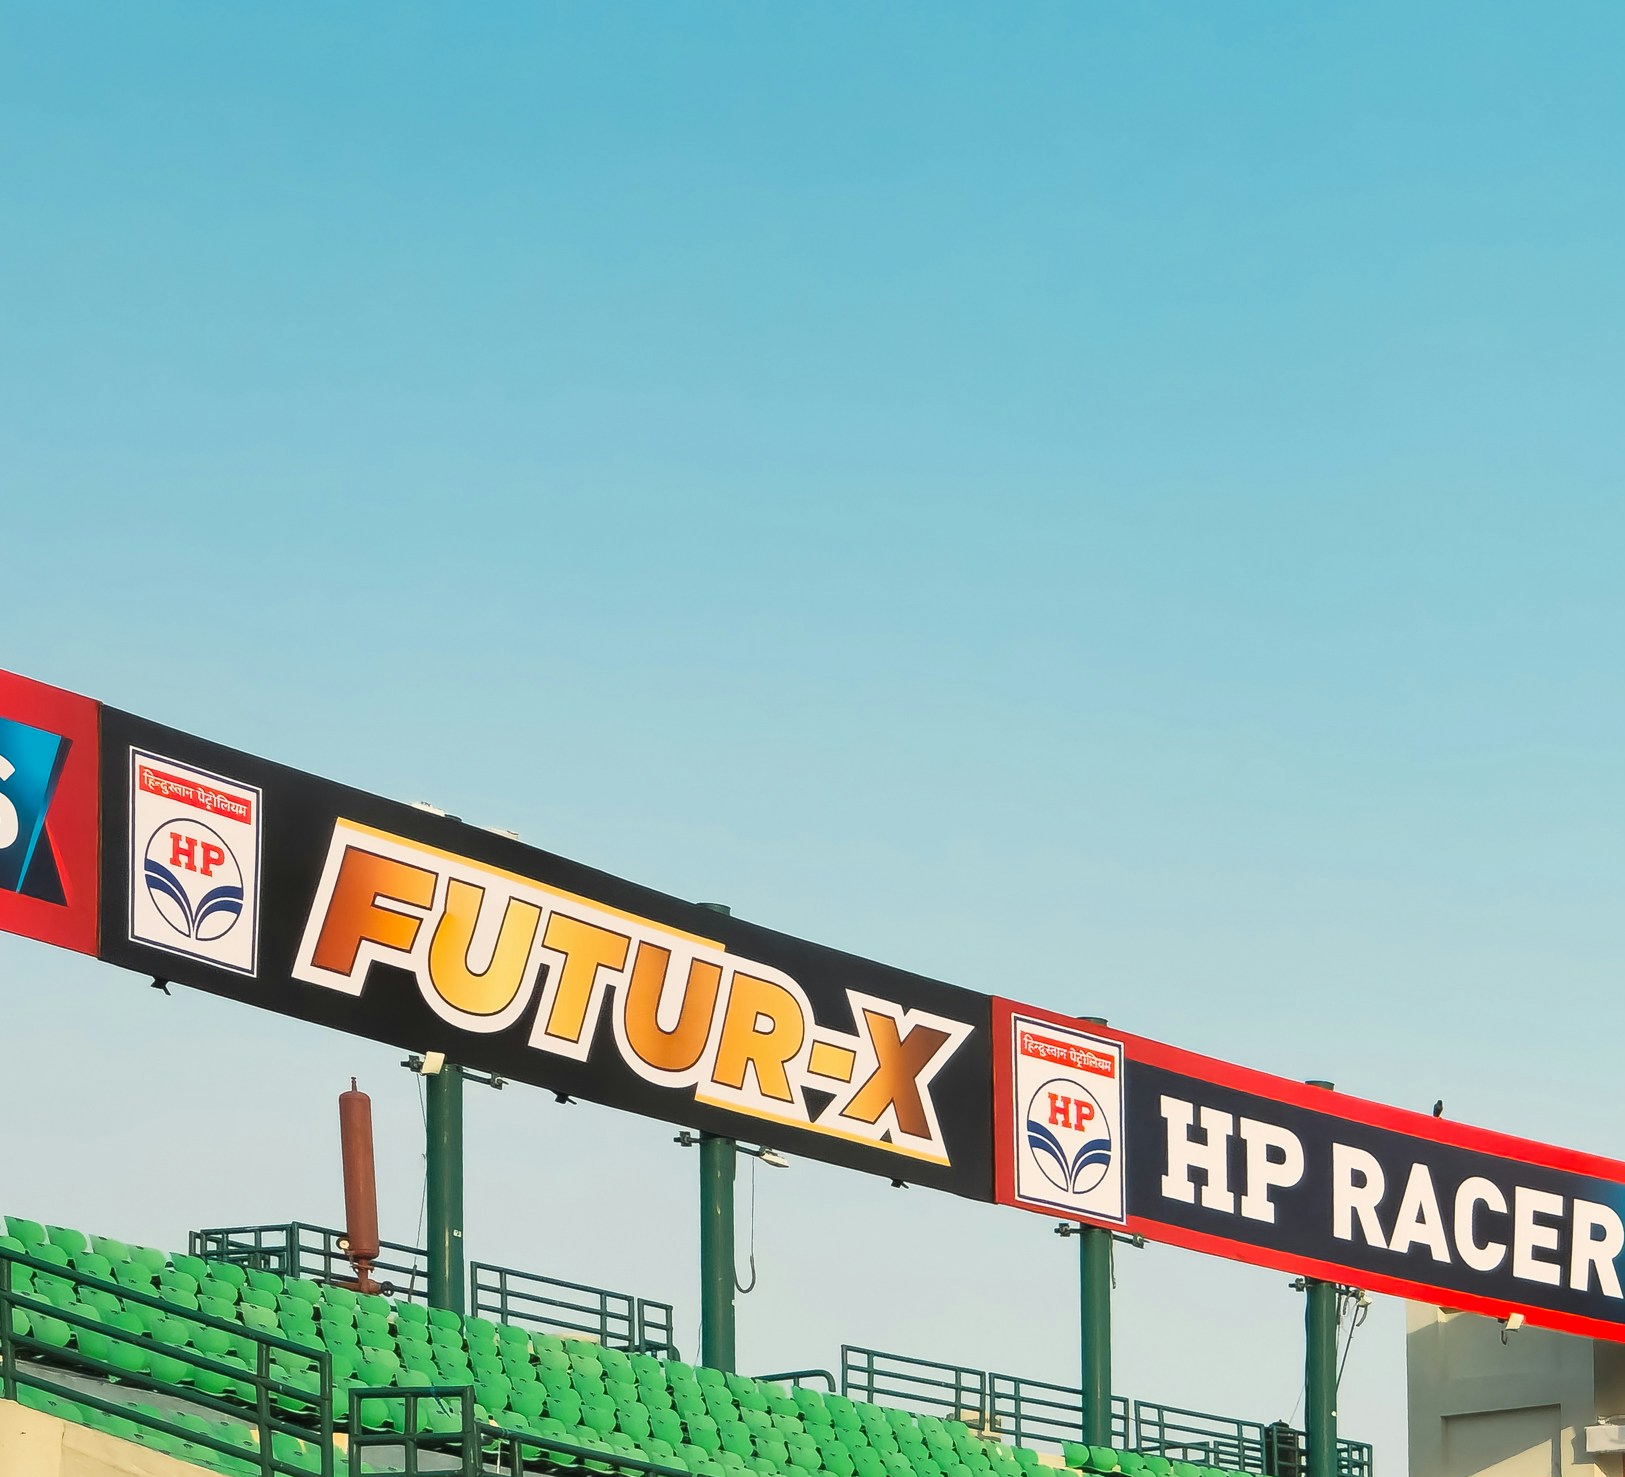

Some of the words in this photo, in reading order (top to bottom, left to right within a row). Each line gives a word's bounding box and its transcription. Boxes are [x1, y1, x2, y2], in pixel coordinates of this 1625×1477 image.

[142, 769, 193, 801] हिन्दुस्तान
[197, 787, 248, 817] पेट्रोलियम
[169, 832, 225, 877] HP
[302, 835, 965, 1150] FUTUR-X
[1048, 1092, 1095, 1133] HP
[1160, 1094, 1304, 1223] HP
[1333, 1142, 1625, 1299] RACER
